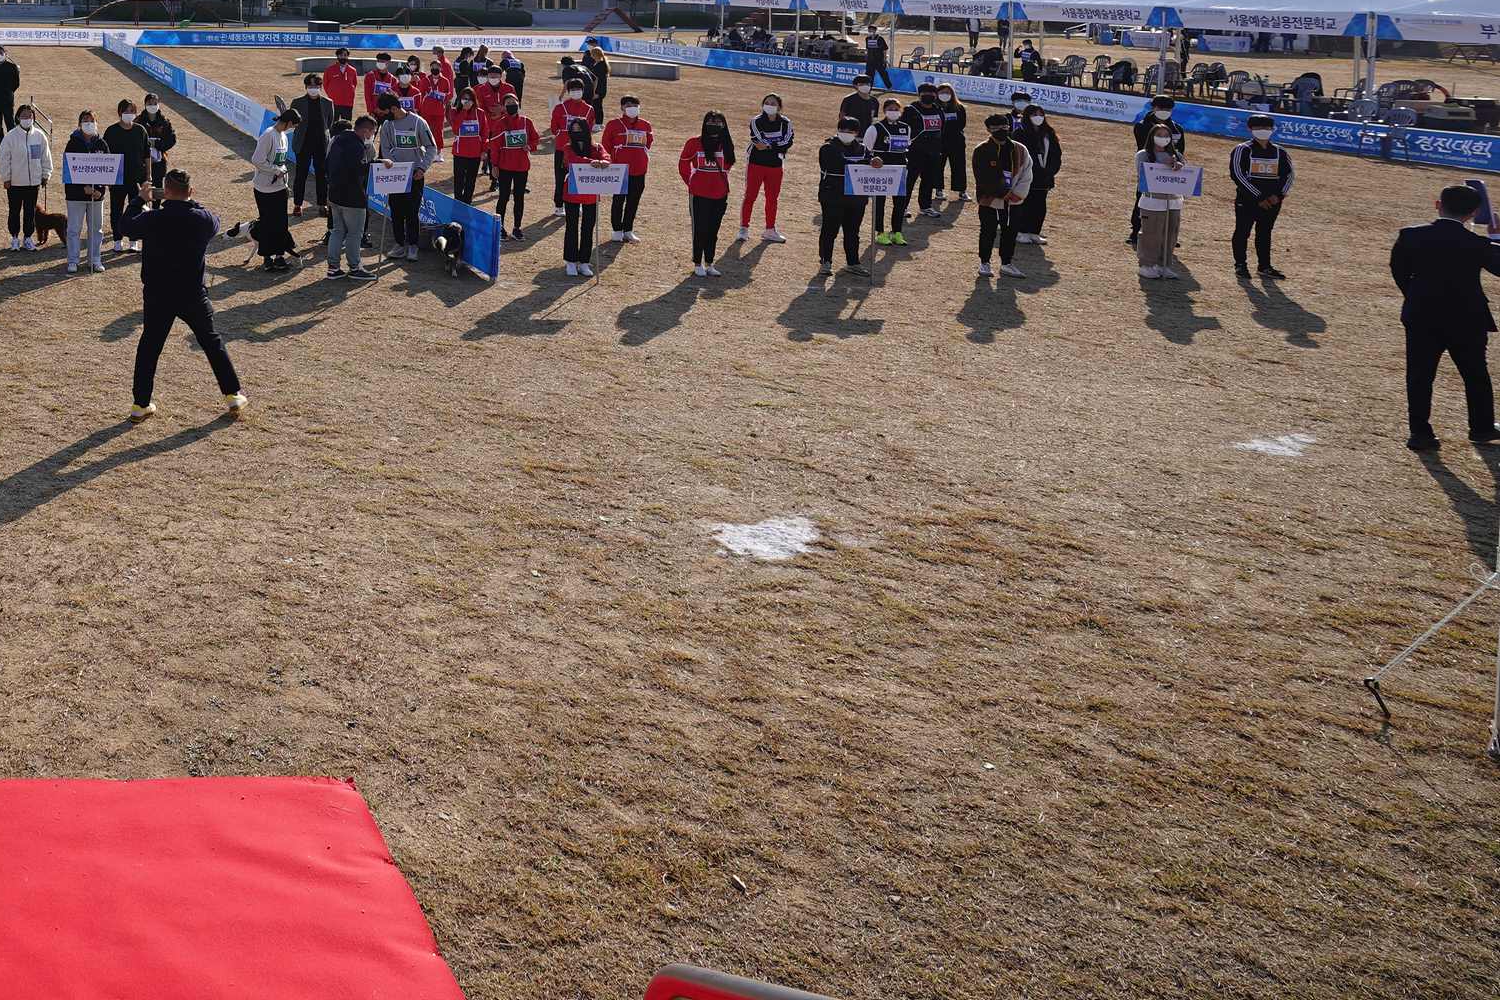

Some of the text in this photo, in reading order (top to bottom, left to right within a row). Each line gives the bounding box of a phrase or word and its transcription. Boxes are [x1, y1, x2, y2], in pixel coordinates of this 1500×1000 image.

[1061, 7, 1142, 22] 서울종합예술실용학교
[1228, 14, 1337, 31] 서울예술실용전문학교
[1030, 87, 1071, 104] 경진대회
[1280, 120, 1354, 142] 관세청장배
[1415, 135, 1493, 158] 경진대회
[578, 175, 621, 184] 계명문화대학교
[1155, 175, 1187, 184] 서정대학교
[863, 185, 888, 193] 전문학교
